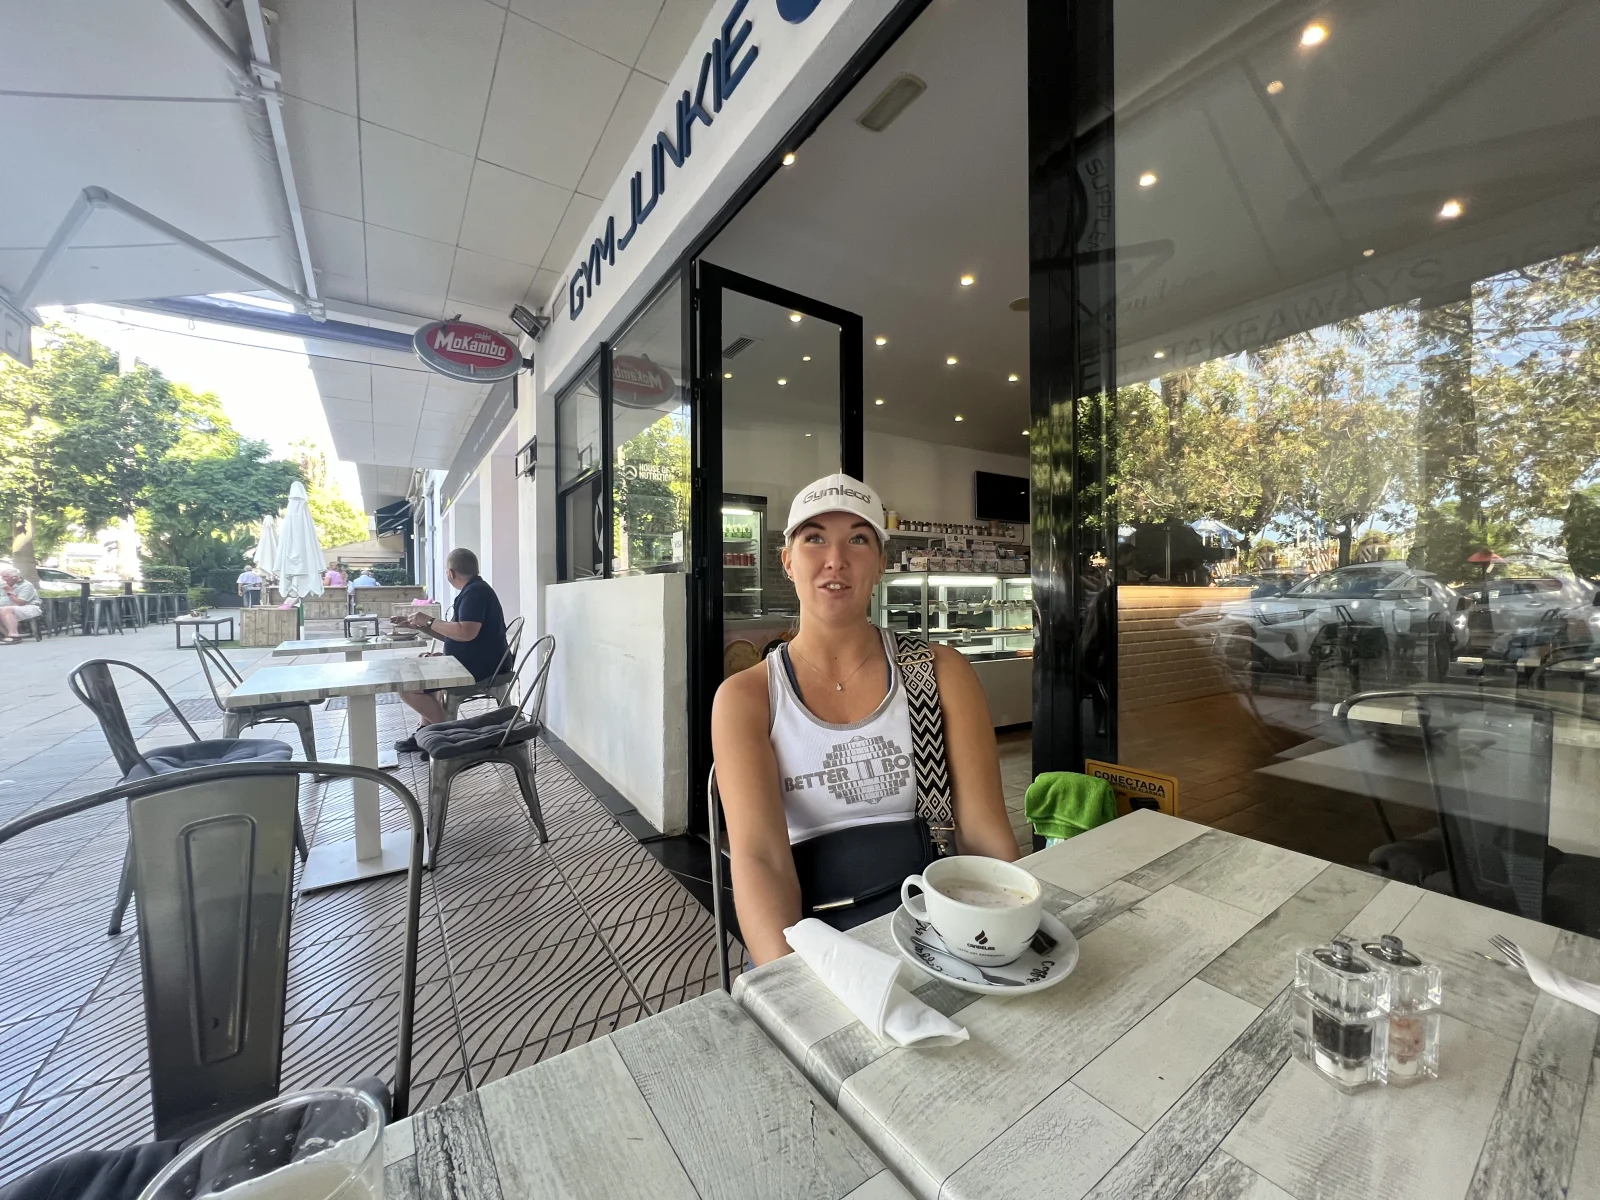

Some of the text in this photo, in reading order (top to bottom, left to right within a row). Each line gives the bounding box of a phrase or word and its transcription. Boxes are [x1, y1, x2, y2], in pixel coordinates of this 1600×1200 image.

[569, 0, 759, 321] GYM JUNKIE
[639, 463, 660, 473] HOUSE
[803, 485, 871, 504] Gymleco
[784, 767, 851, 792] BETTER
[1094, 770, 1166, 794] CONECTADA
[1138, 787, 1166, 799] ALARMAS
